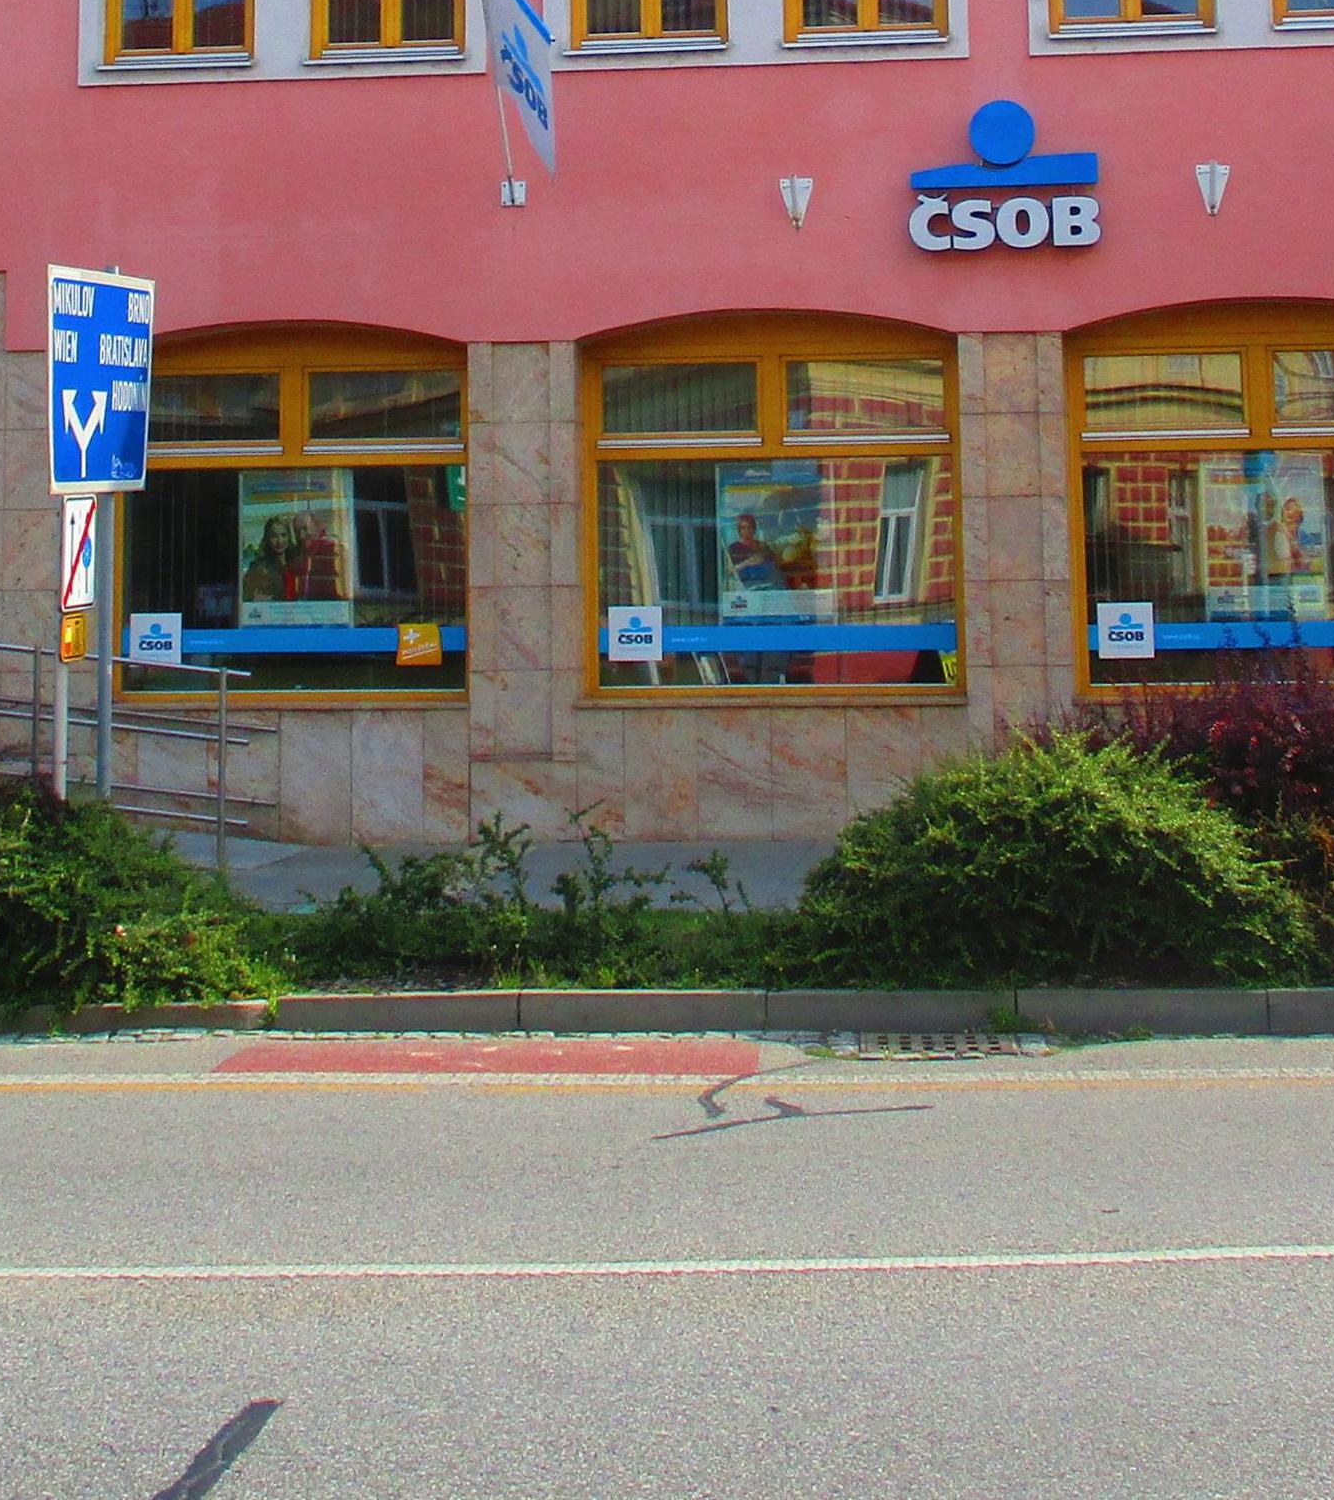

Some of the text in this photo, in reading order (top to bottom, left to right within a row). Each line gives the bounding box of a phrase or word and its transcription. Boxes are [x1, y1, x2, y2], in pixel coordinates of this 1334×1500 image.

[908, 192, 1102, 252] ČSOB
[53, 281, 96, 318] MIKULOV
[127, 291, 151, 325] BRNO
[53, 329, 79, 363] WIEN
[99, 333, 148, 369] BRATISLAVA
[111, 374, 147, 412] HODONÍN
